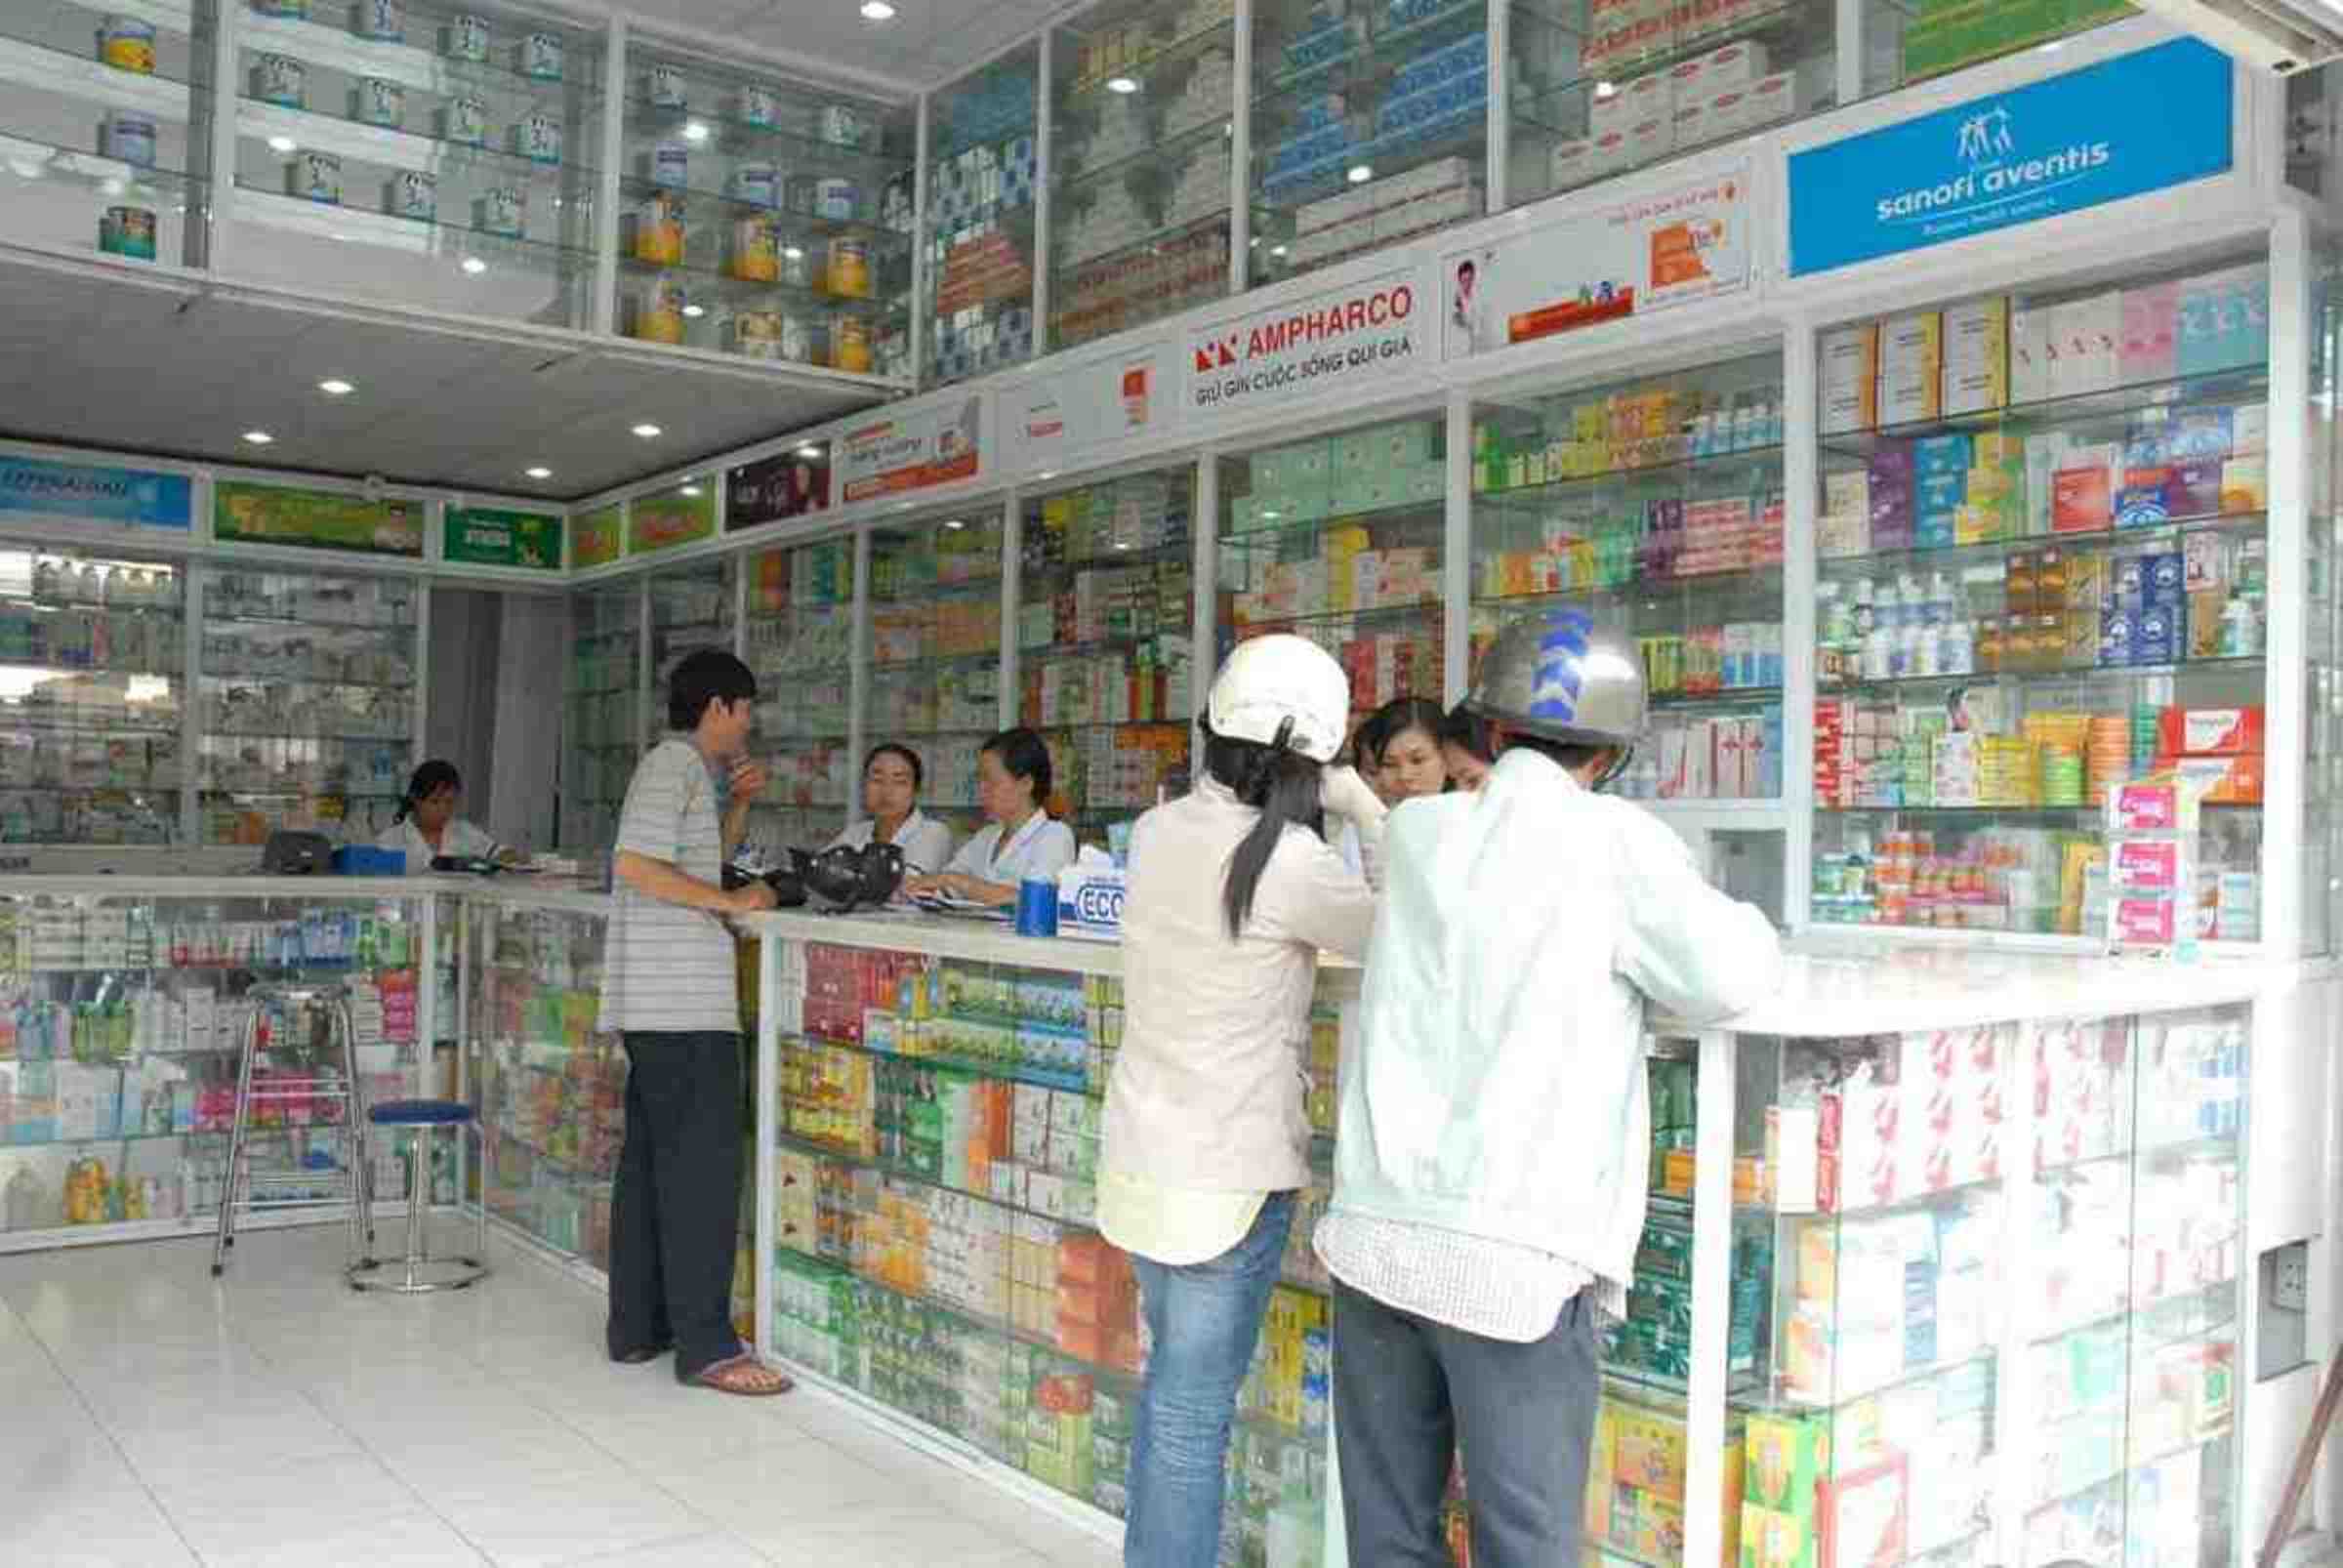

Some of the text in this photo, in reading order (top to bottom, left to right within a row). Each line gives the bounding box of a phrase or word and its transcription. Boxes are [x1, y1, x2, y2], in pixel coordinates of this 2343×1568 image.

[1876, 173, 1973, 220] sanofi
[1983, 142, 2110, 192] aventis
[1249, 286, 1412, 359] AMPHARCO
